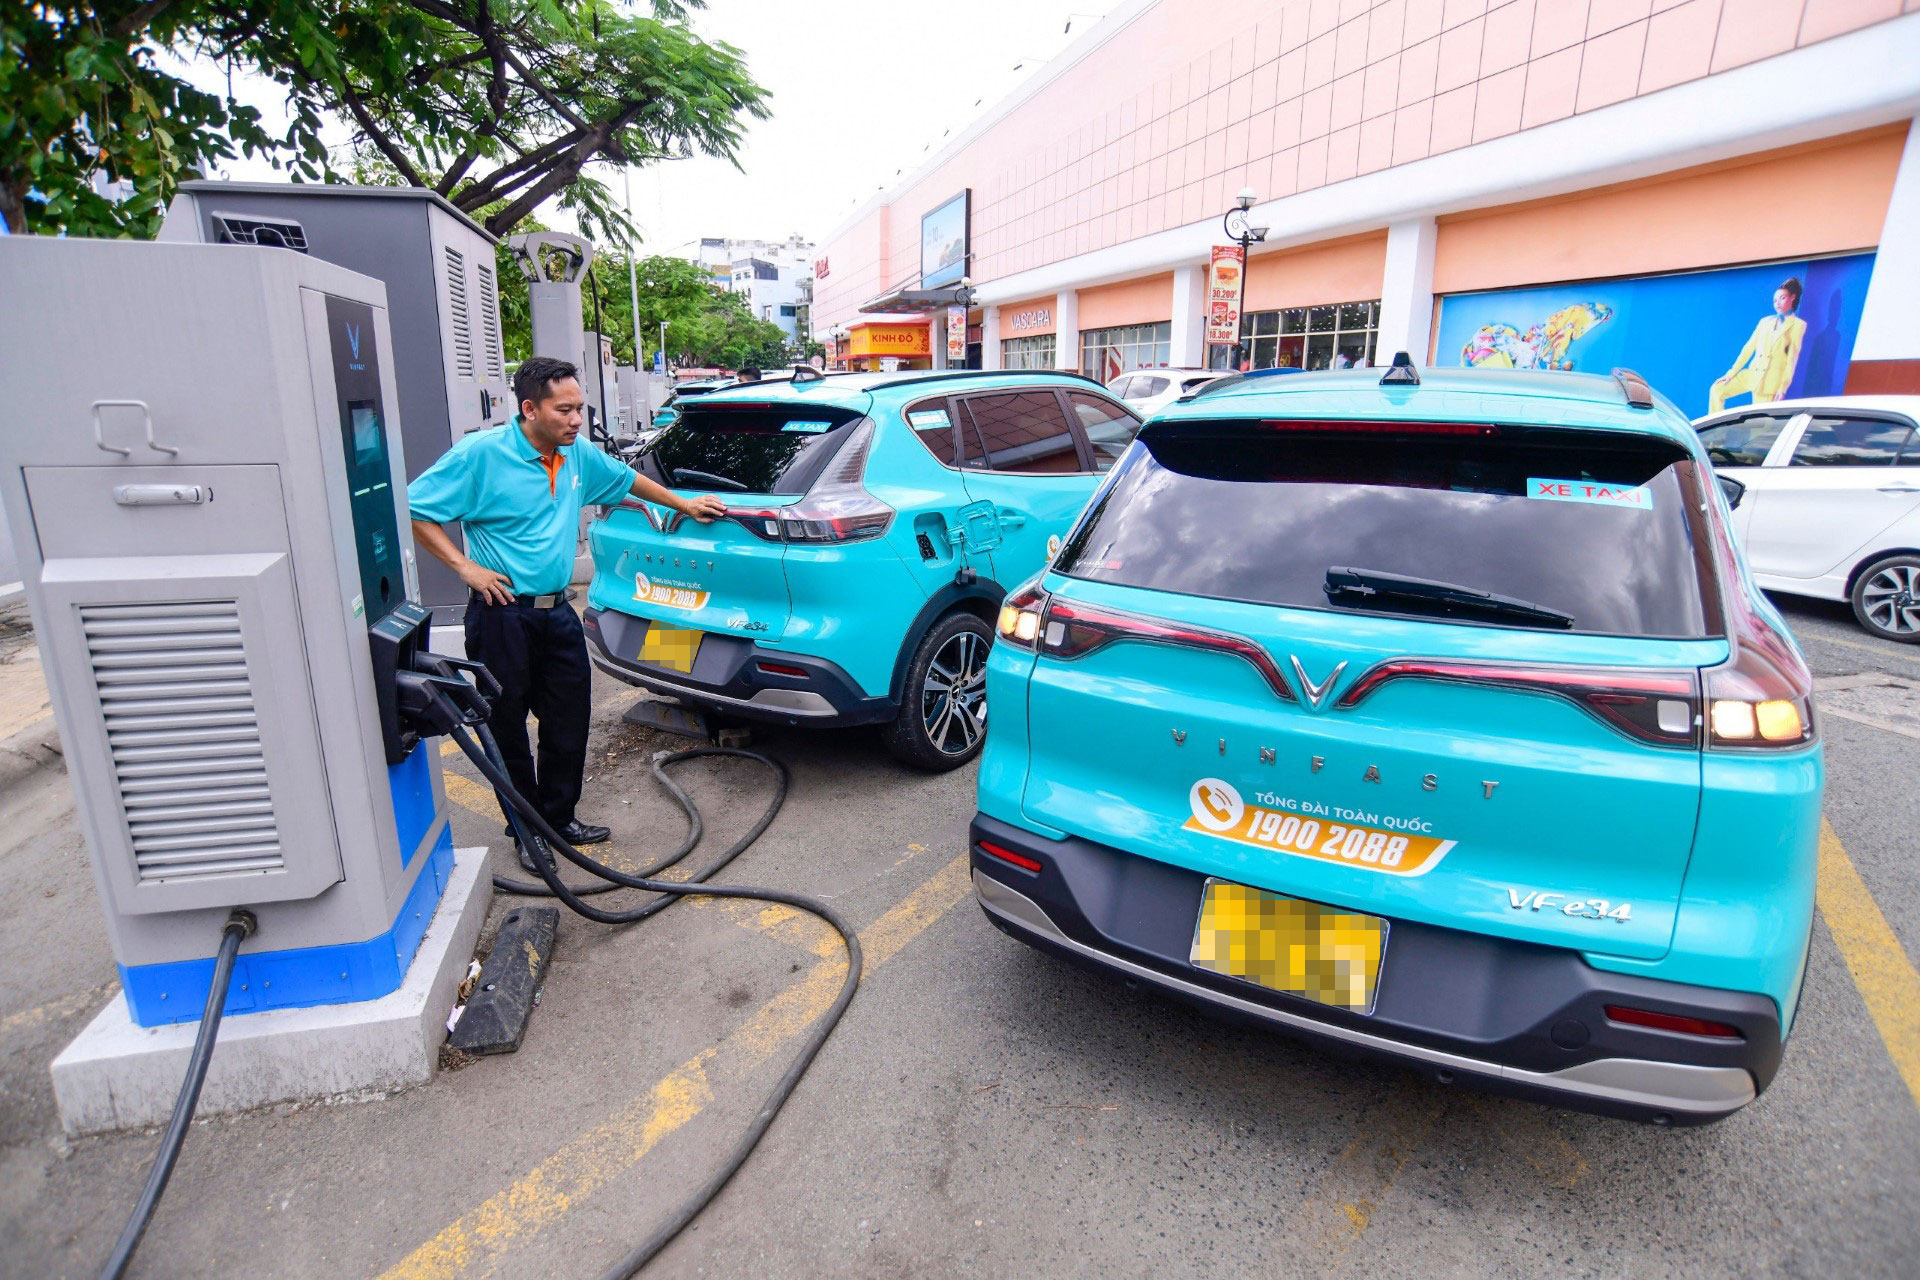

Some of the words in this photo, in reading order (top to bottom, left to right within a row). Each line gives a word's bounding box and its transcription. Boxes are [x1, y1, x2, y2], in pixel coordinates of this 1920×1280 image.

[1011, 308, 1051, 331] VASCARA
[872, 334, 896, 343] KINH
[898, 332, 914, 343] ĐÔ
[1538, 483, 1572, 497] XE
[1580, 485, 1641, 503] TAXI
[651, 585, 672, 602] 1900
[671, 589, 697, 607] 2088
[1171, 728, 1500, 800] VINFAST
[1255, 791, 1297, 810] TỔNG
[1301, 800, 1329, 816] ĐÀI
[1333, 806, 1378, 825] TOÀN
[1383, 815, 1433, 834] QUỐC
[1246, 810, 1320, 850] 1900
[1320, 825, 1409, 867] 2088
[1507, 888, 1565, 912] VF
[1560, 899, 1633, 924] e34
